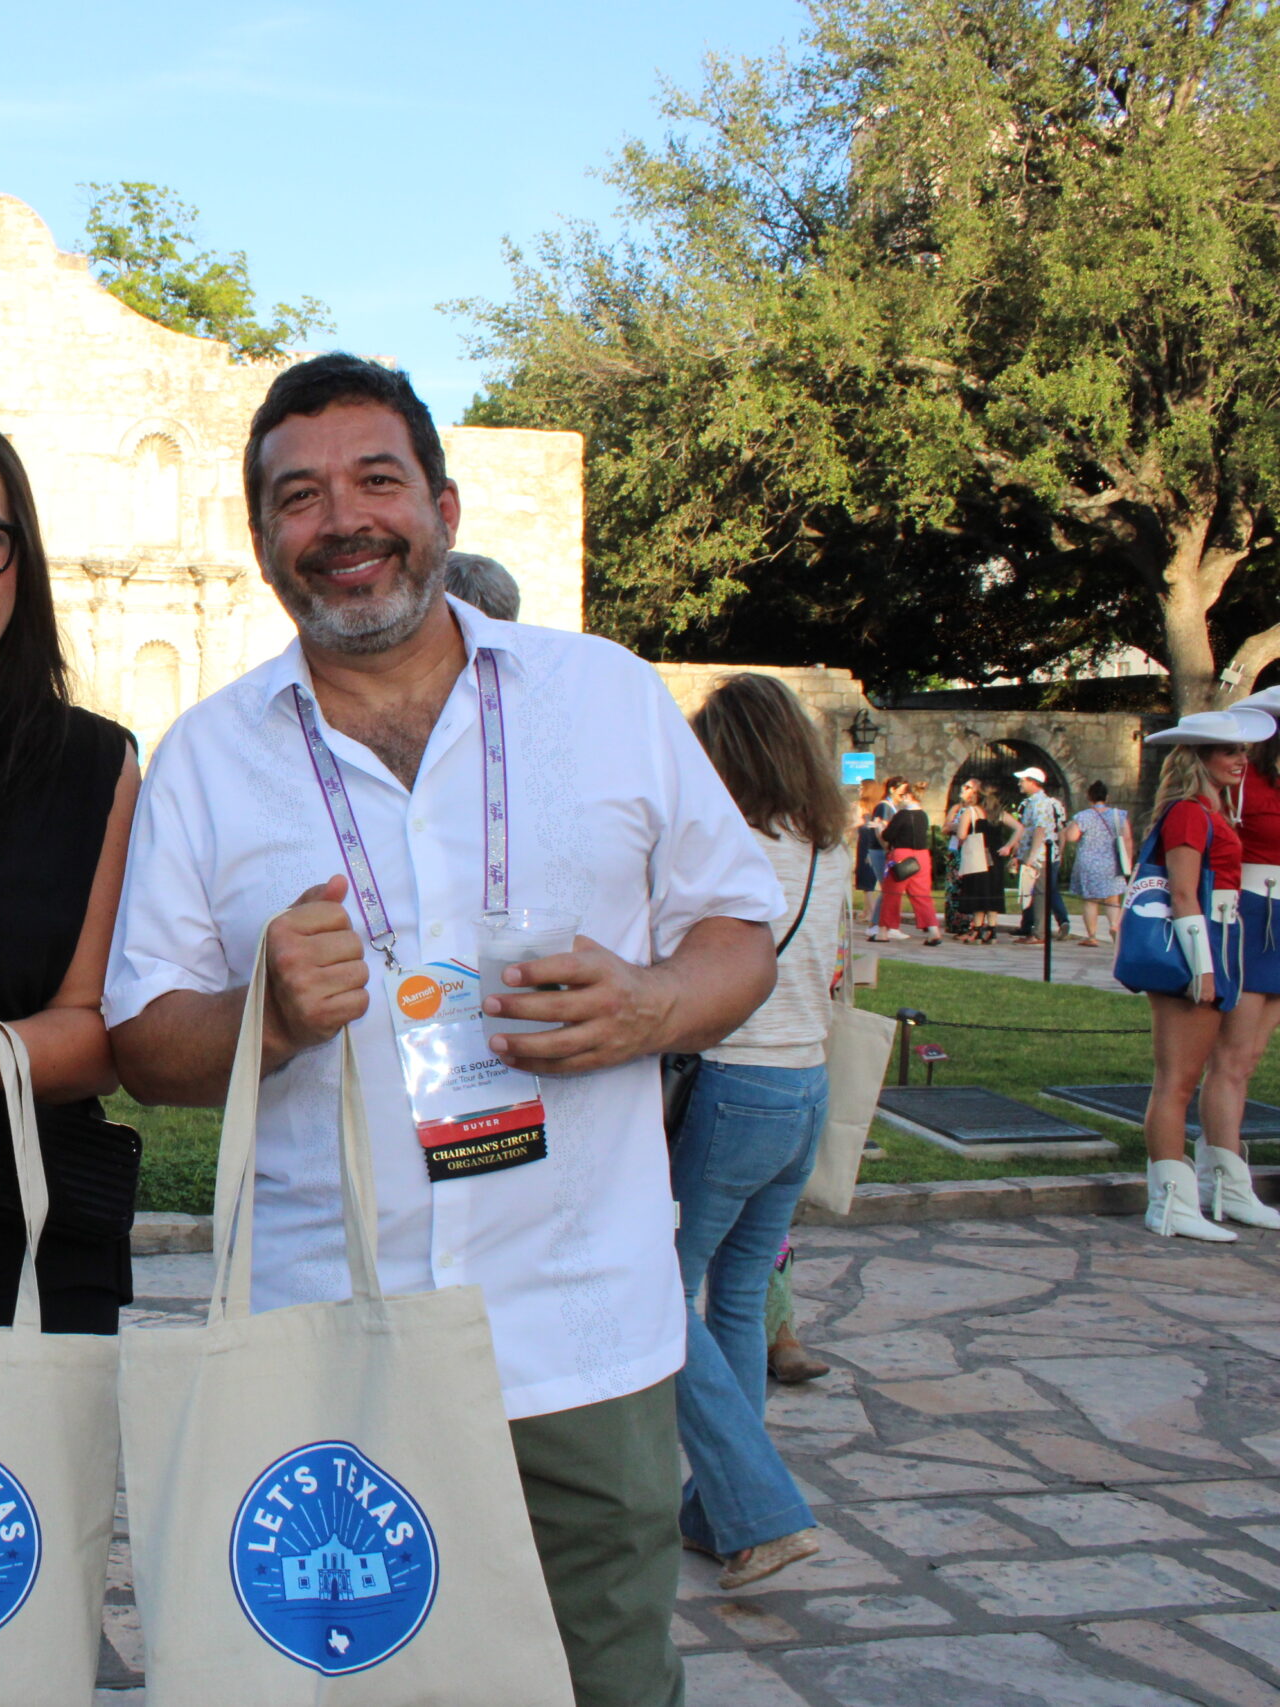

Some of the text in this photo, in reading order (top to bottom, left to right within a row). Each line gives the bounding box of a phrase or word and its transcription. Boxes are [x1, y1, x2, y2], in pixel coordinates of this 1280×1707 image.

[439, 980, 465, 996] ipw
[469, 1058, 502, 1071] SOUZA
[463, 1119, 500, 1131] BUYER
[432, 1131, 540, 1160] CHAIRMAN'S CIRCLE
[447, 1146, 529, 1170] ORGANIZATION
[248, 1458, 414, 1553] LET'S TEXAS
